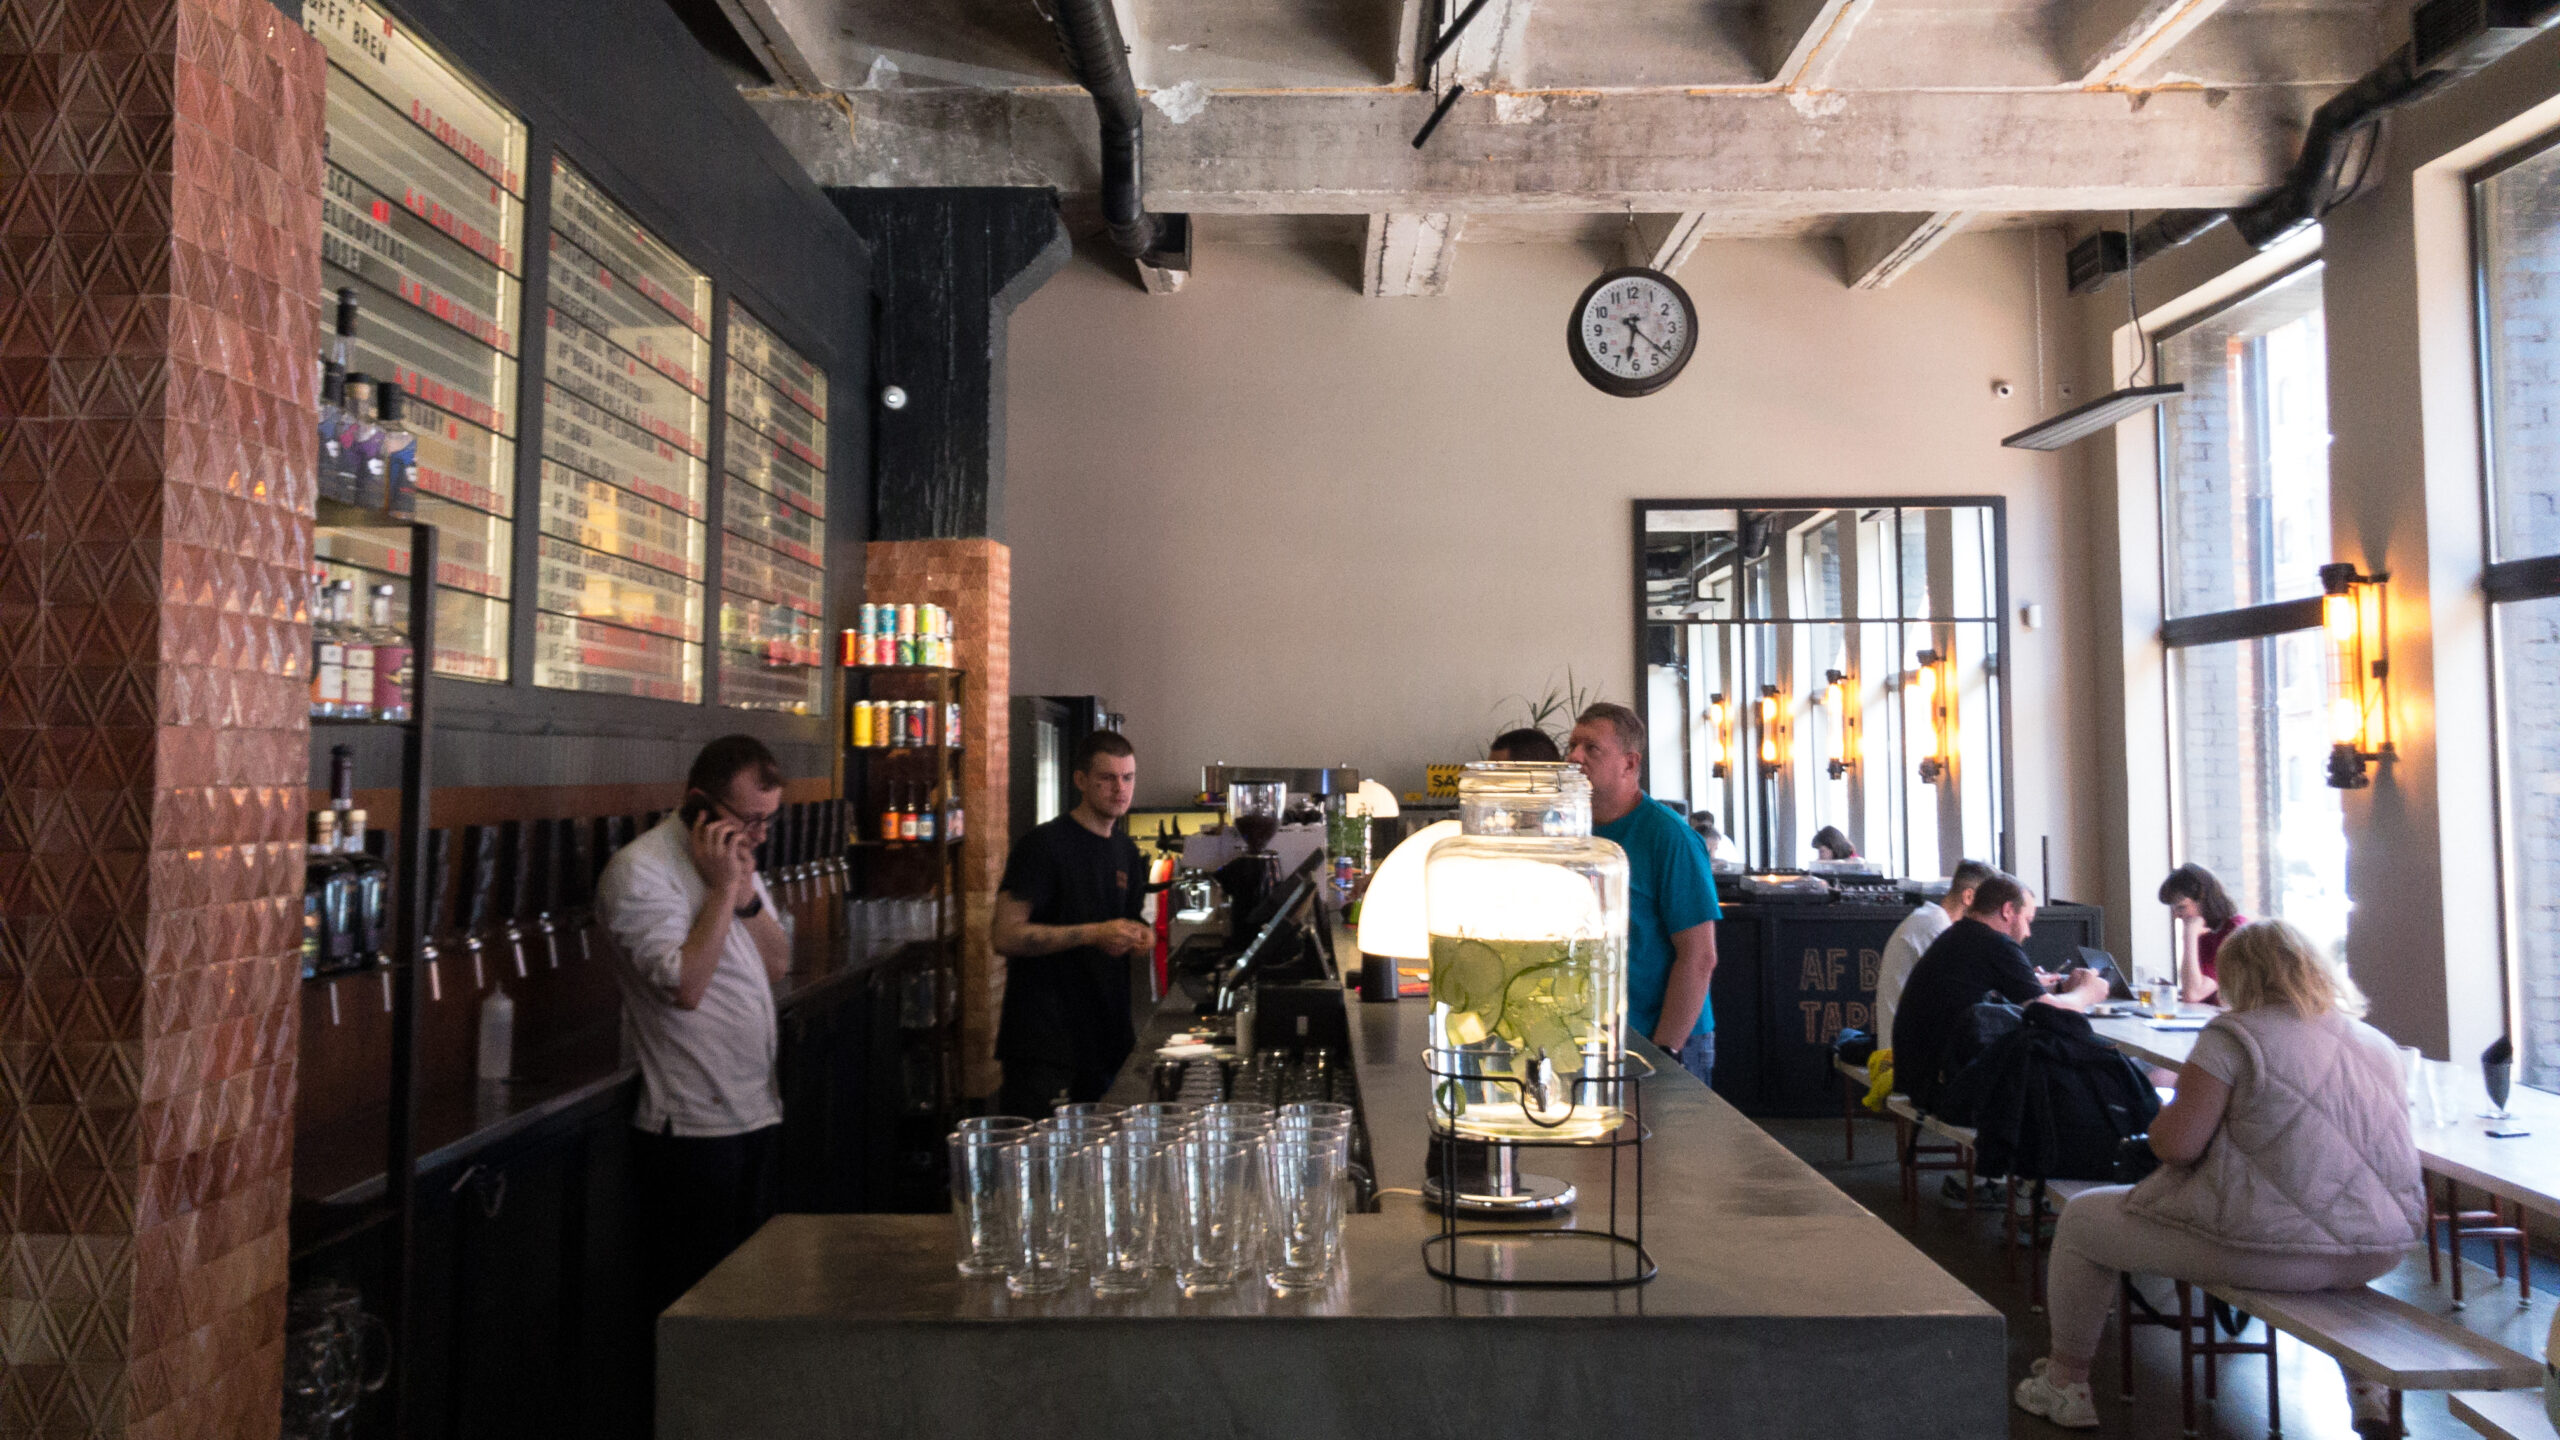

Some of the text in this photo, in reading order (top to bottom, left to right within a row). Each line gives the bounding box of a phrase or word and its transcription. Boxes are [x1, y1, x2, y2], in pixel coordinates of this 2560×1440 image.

[353, 20, 386, 64] BREW
[1611, 291, 1620, 304] 11
[1627, 287, 1639, 299] 12
[1596, 306, 1608, 318] 10
[1661, 303, 1669, 316] 2
[1594, 324, 1602, 336] 9
[1667, 322, 1676, 334] 3
[1599, 342, 1608, 354] 8
[1662, 340, 1671, 351] 4
[1612, 355, 1621, 367] 7
[1632, 359, 1640, 371] 6
[1651, 353, 1659, 366] 5
[1432, 774, 1461, 787] SA
[1800, 948, 1880, 991] AF B
